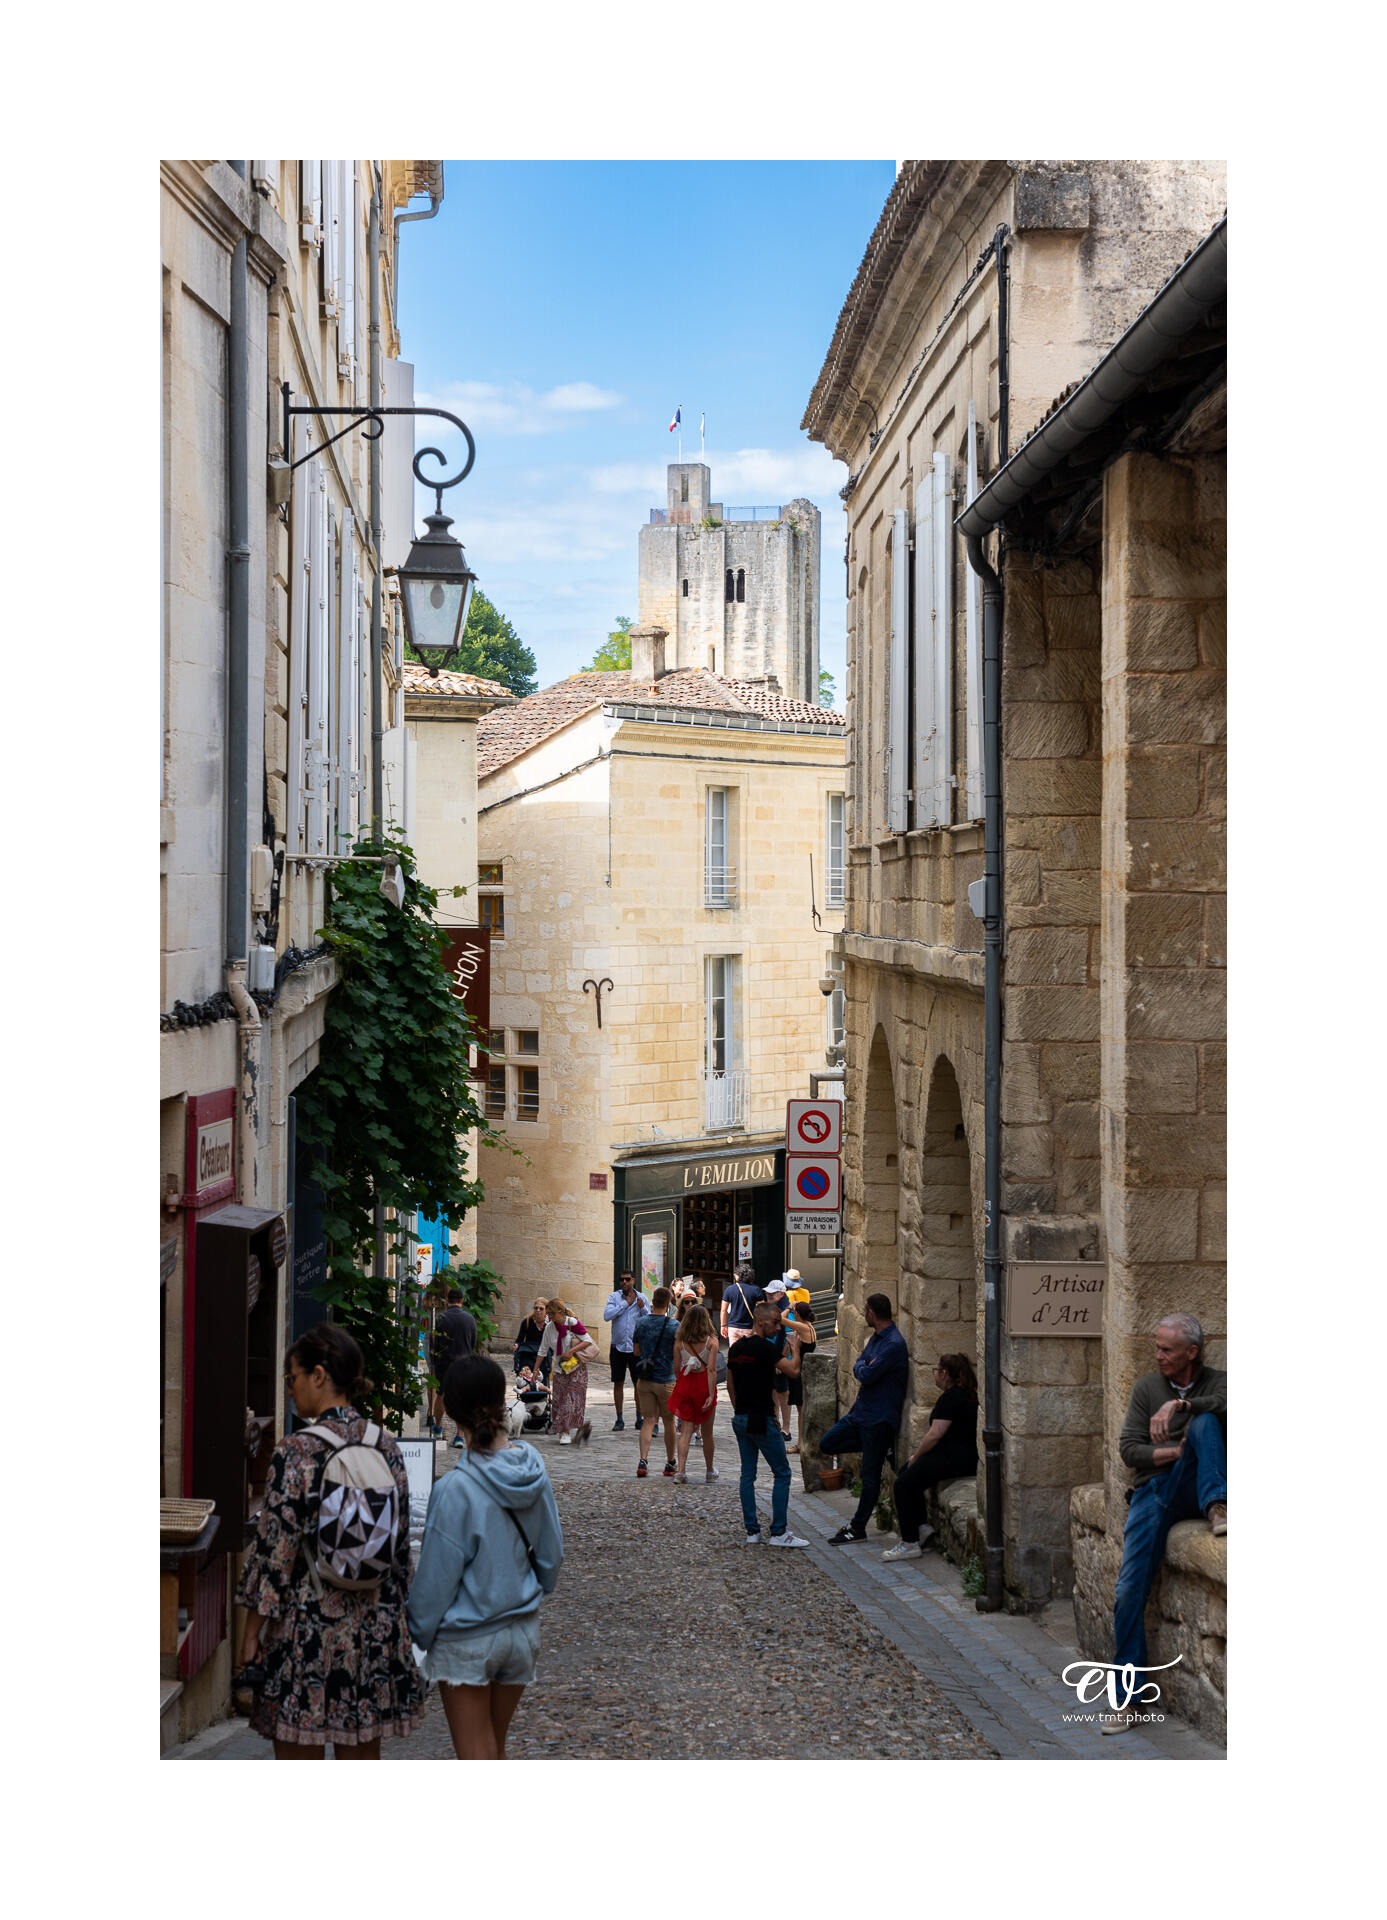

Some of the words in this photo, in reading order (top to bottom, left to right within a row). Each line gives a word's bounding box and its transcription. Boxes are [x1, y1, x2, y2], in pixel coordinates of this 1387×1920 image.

[446, 942, 485, 1000] CHON
[200, 1136, 230, 1182] Créateurs
[684, 1158, 776, 1188] L'EMILION
[294, 1242, 324, 1266] outique
